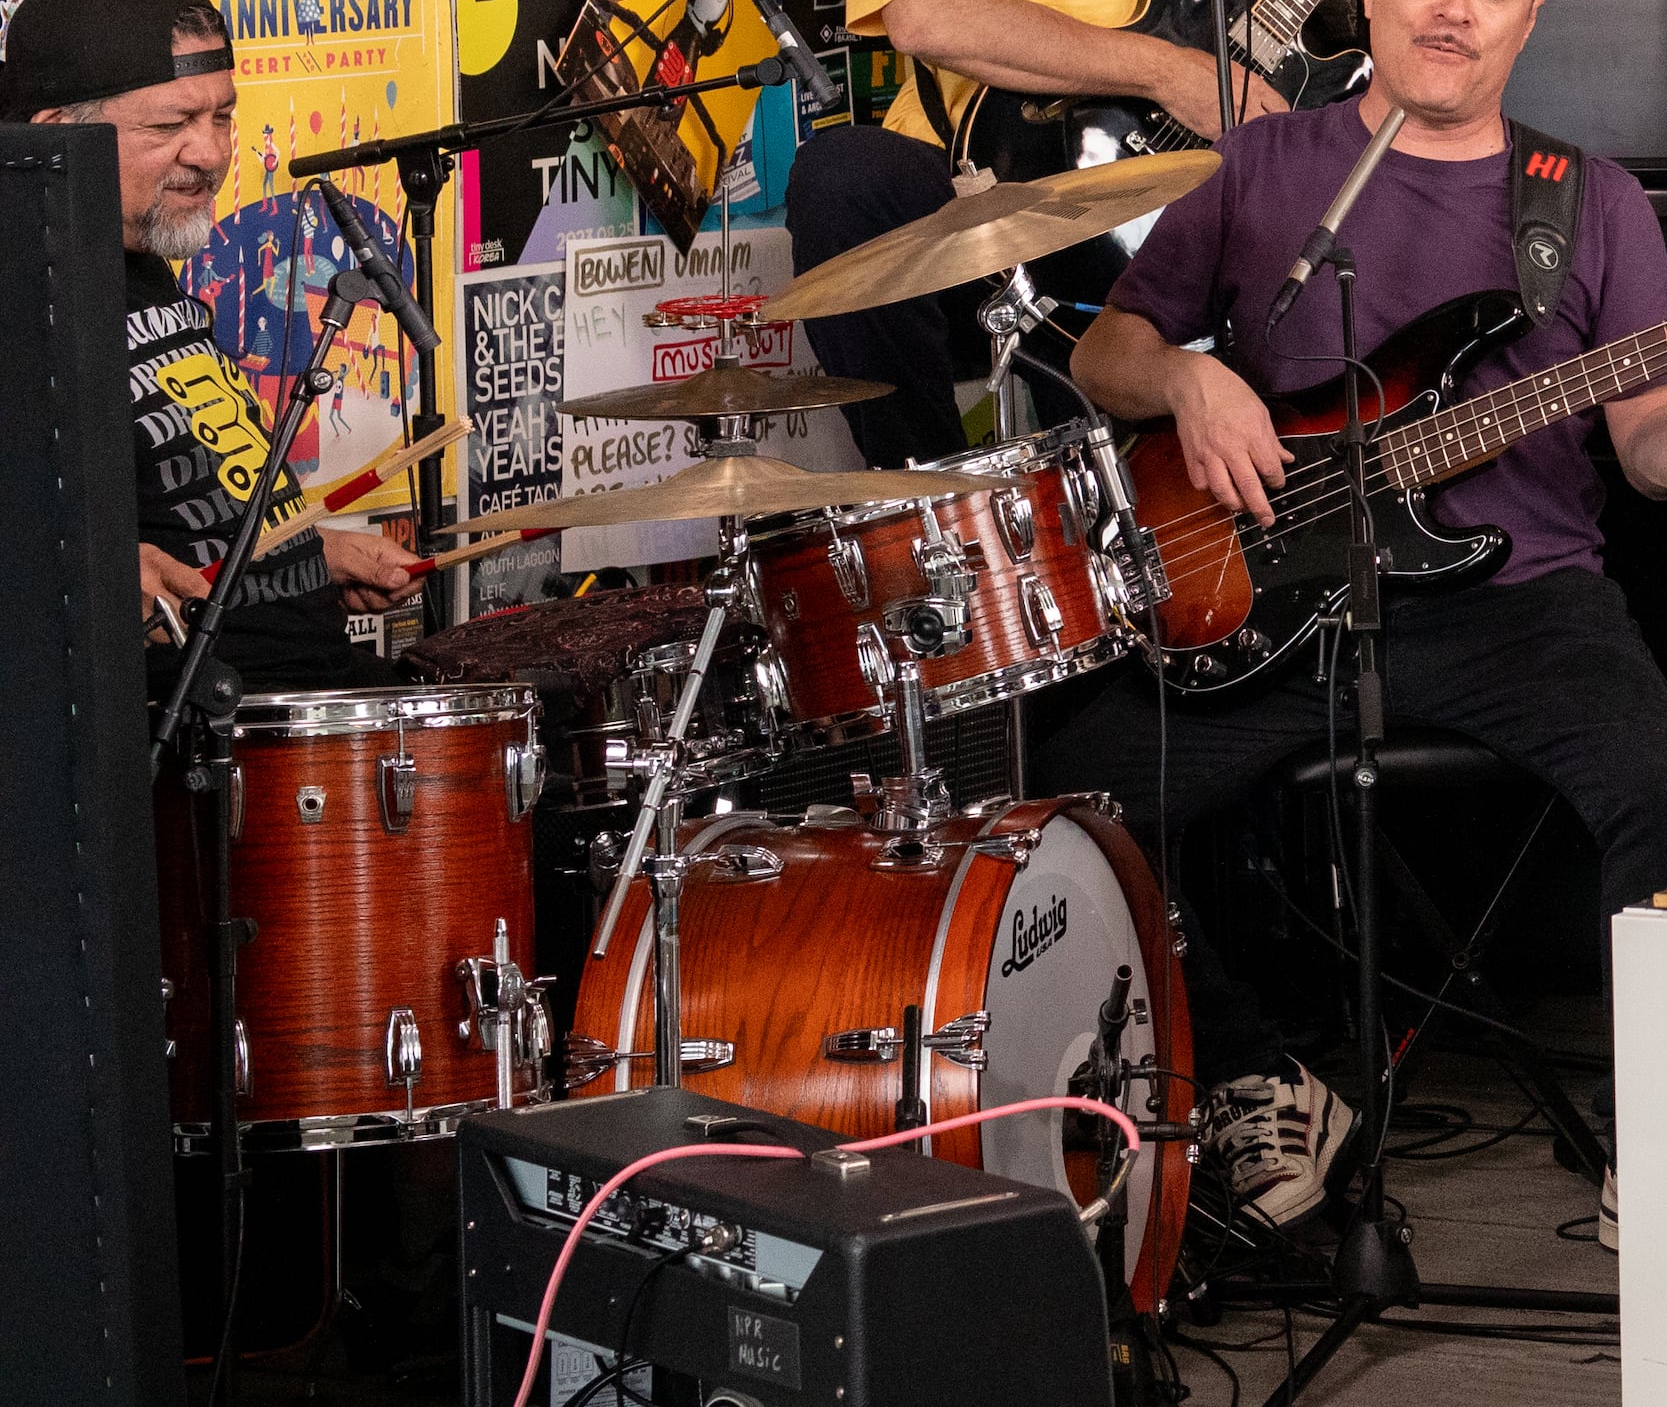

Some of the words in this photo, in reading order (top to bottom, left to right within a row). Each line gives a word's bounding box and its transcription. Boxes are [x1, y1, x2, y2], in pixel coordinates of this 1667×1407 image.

[326, 47, 387, 69] PARTY
[531, 150, 620, 208] TINY
[470, 242, 485, 254] tiny
[485, 240, 503, 252] desk
[472, 251, 502, 264] KOREA
[579, 245, 659, 291] BOWEN
[473, 286, 541, 332] NICK
[573, 301, 628, 348] HEY
[474, 331, 495, 368] &
[496, 323, 545, 362] THE
[474, 357, 562, 403] SEEDS
[475, 405, 552, 448] YEAH
[476, 435, 563, 483] YEAHS
[570, 423, 675, 481] PLEASE?
[479, 484, 523, 517] CAFÉ
[478, 557, 516, 579] YOUTH
[517, 551, 561, 573] LAGOON
[999, 894, 1070, 980] Ludwig
[1033, 939, 1055, 957] USA
[734, 1315, 764, 1340] NPR
